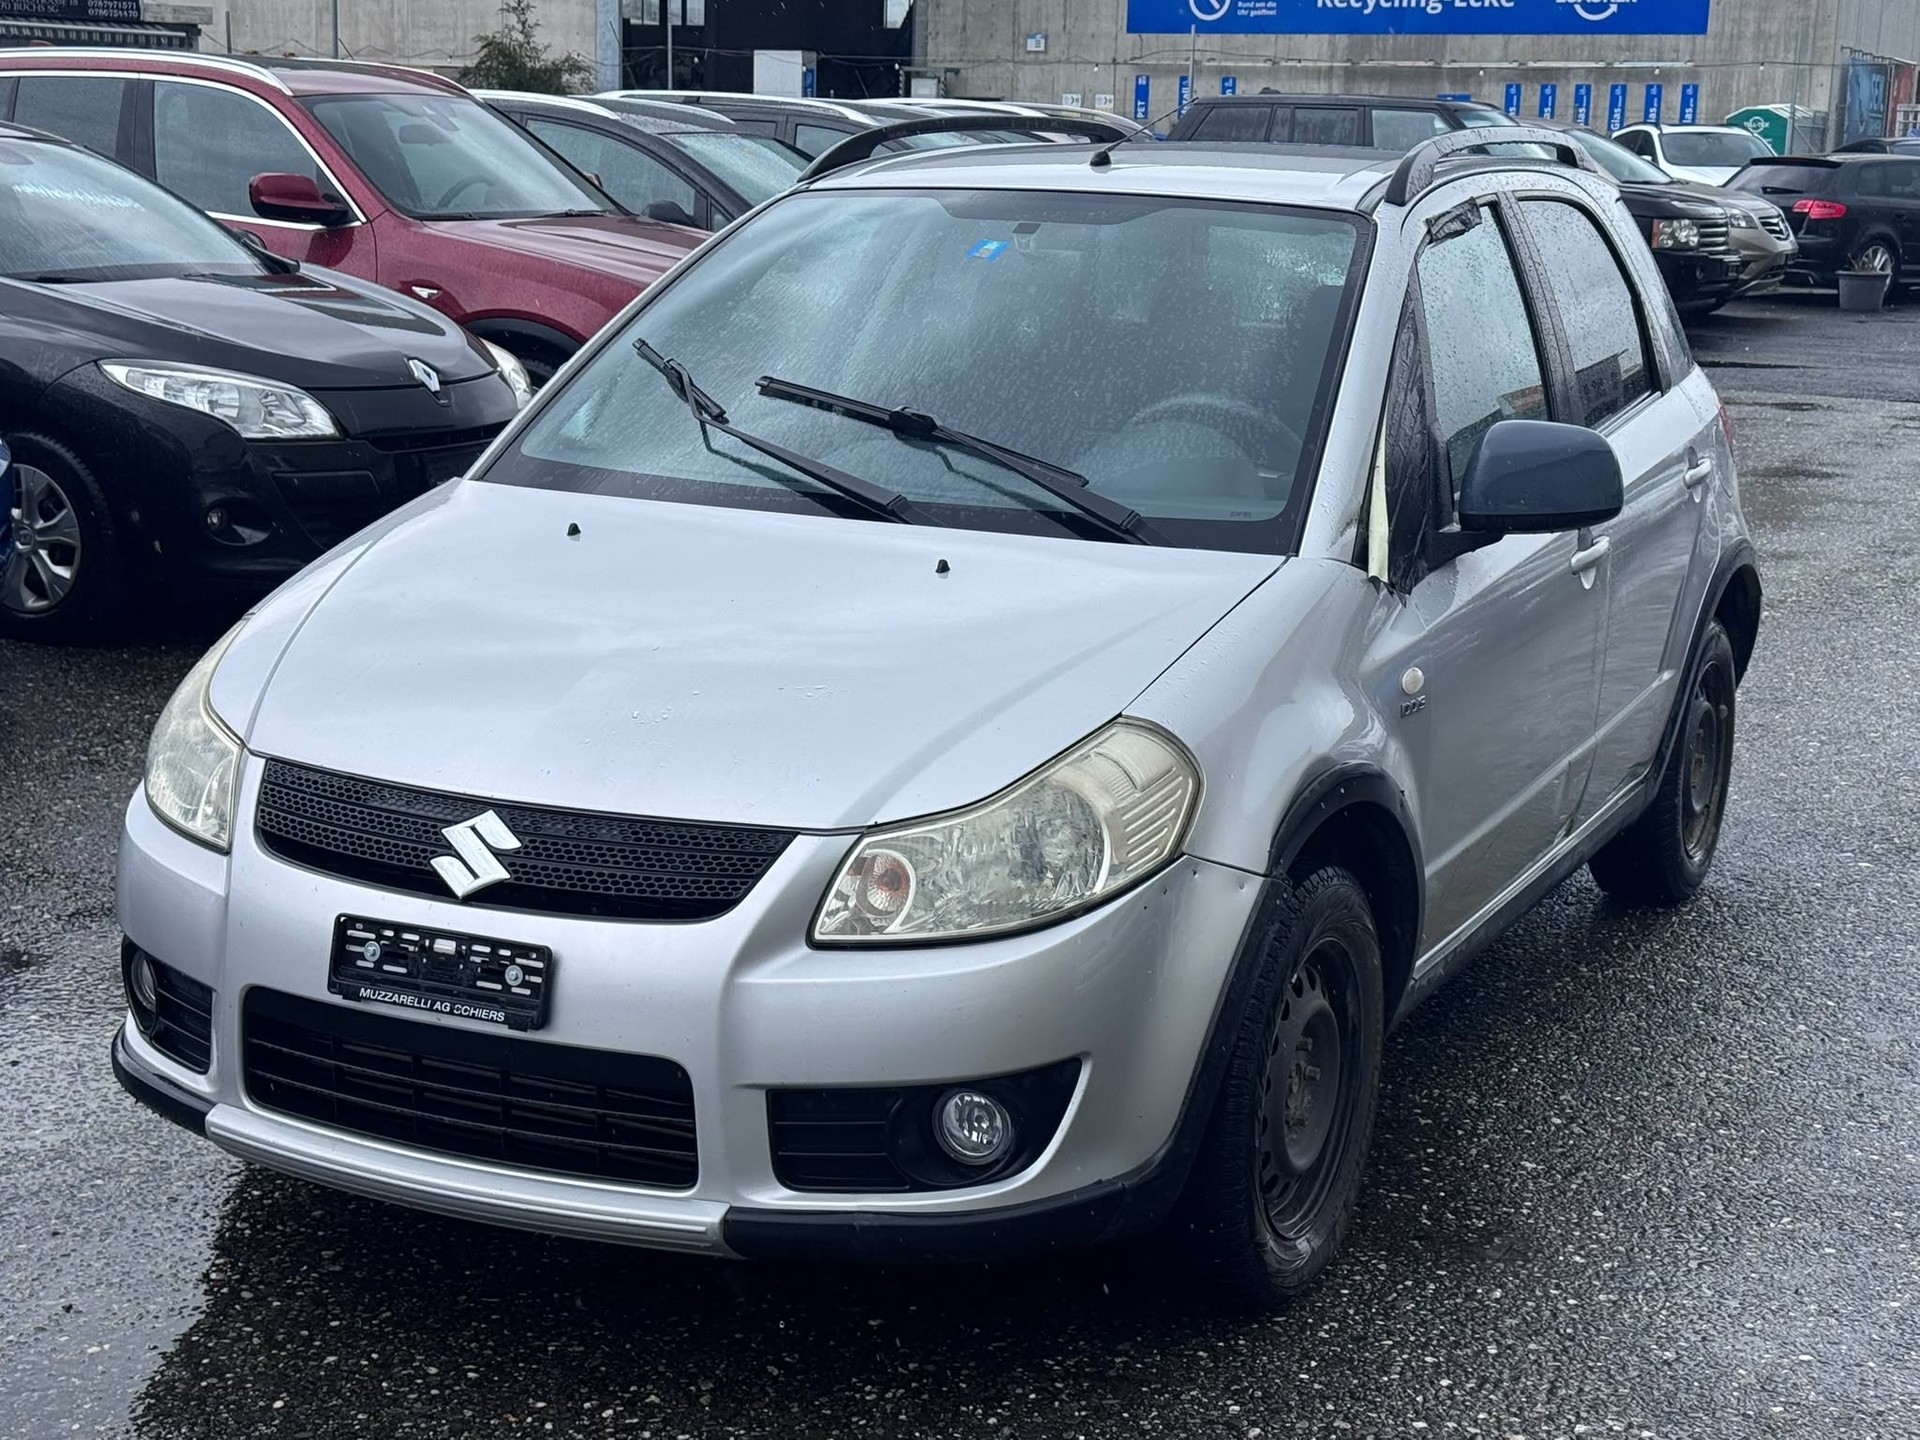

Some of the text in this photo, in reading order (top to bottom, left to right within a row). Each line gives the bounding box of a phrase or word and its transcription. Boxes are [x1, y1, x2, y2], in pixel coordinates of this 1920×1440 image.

[1136, 100, 1146, 118] PET
[1577, 107, 1587, 126] las
[1646, 107, 1658, 123] las
[1682, 107, 1694, 123] las
[1610, 107, 1622, 131] Glas
[359, 987, 505, 1022] MUZZARELLI AG SCHIERS
